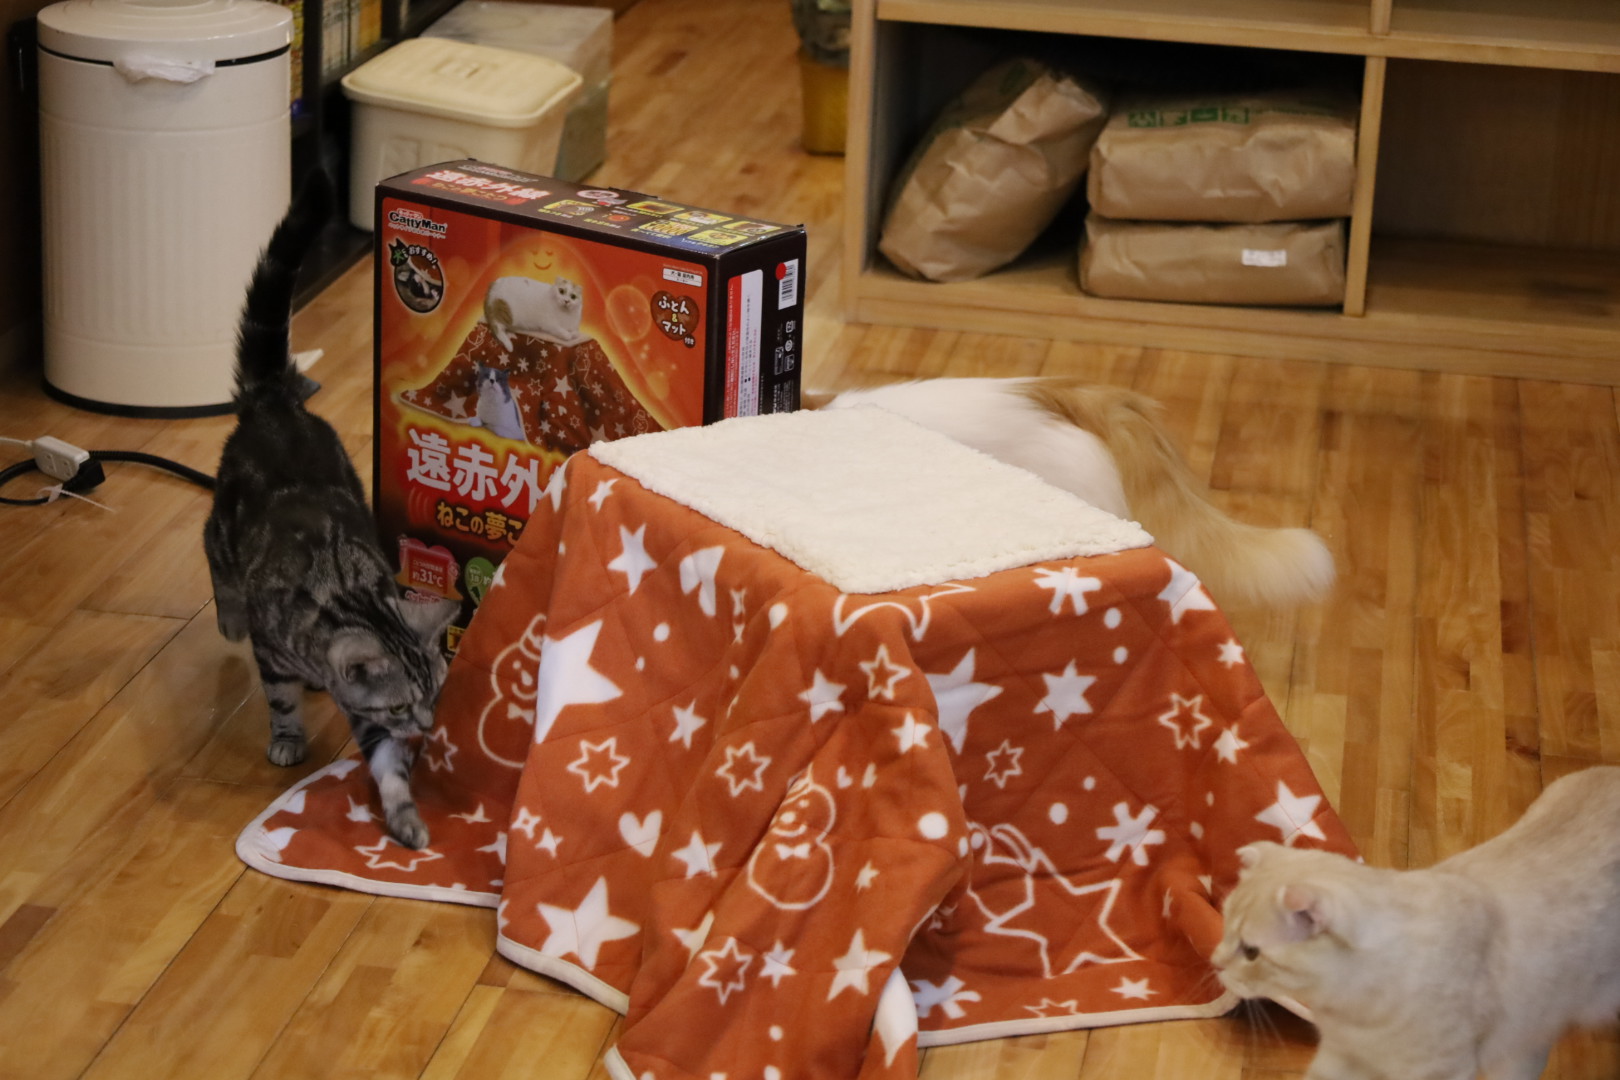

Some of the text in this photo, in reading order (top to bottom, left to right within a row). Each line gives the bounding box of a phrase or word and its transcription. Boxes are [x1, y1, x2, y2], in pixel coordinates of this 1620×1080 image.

[388, 211, 446, 233] CattyMan
[658, 295, 690, 315] ふとん
[671, 312, 678, 323] &
[662, 320, 687, 336] マット
